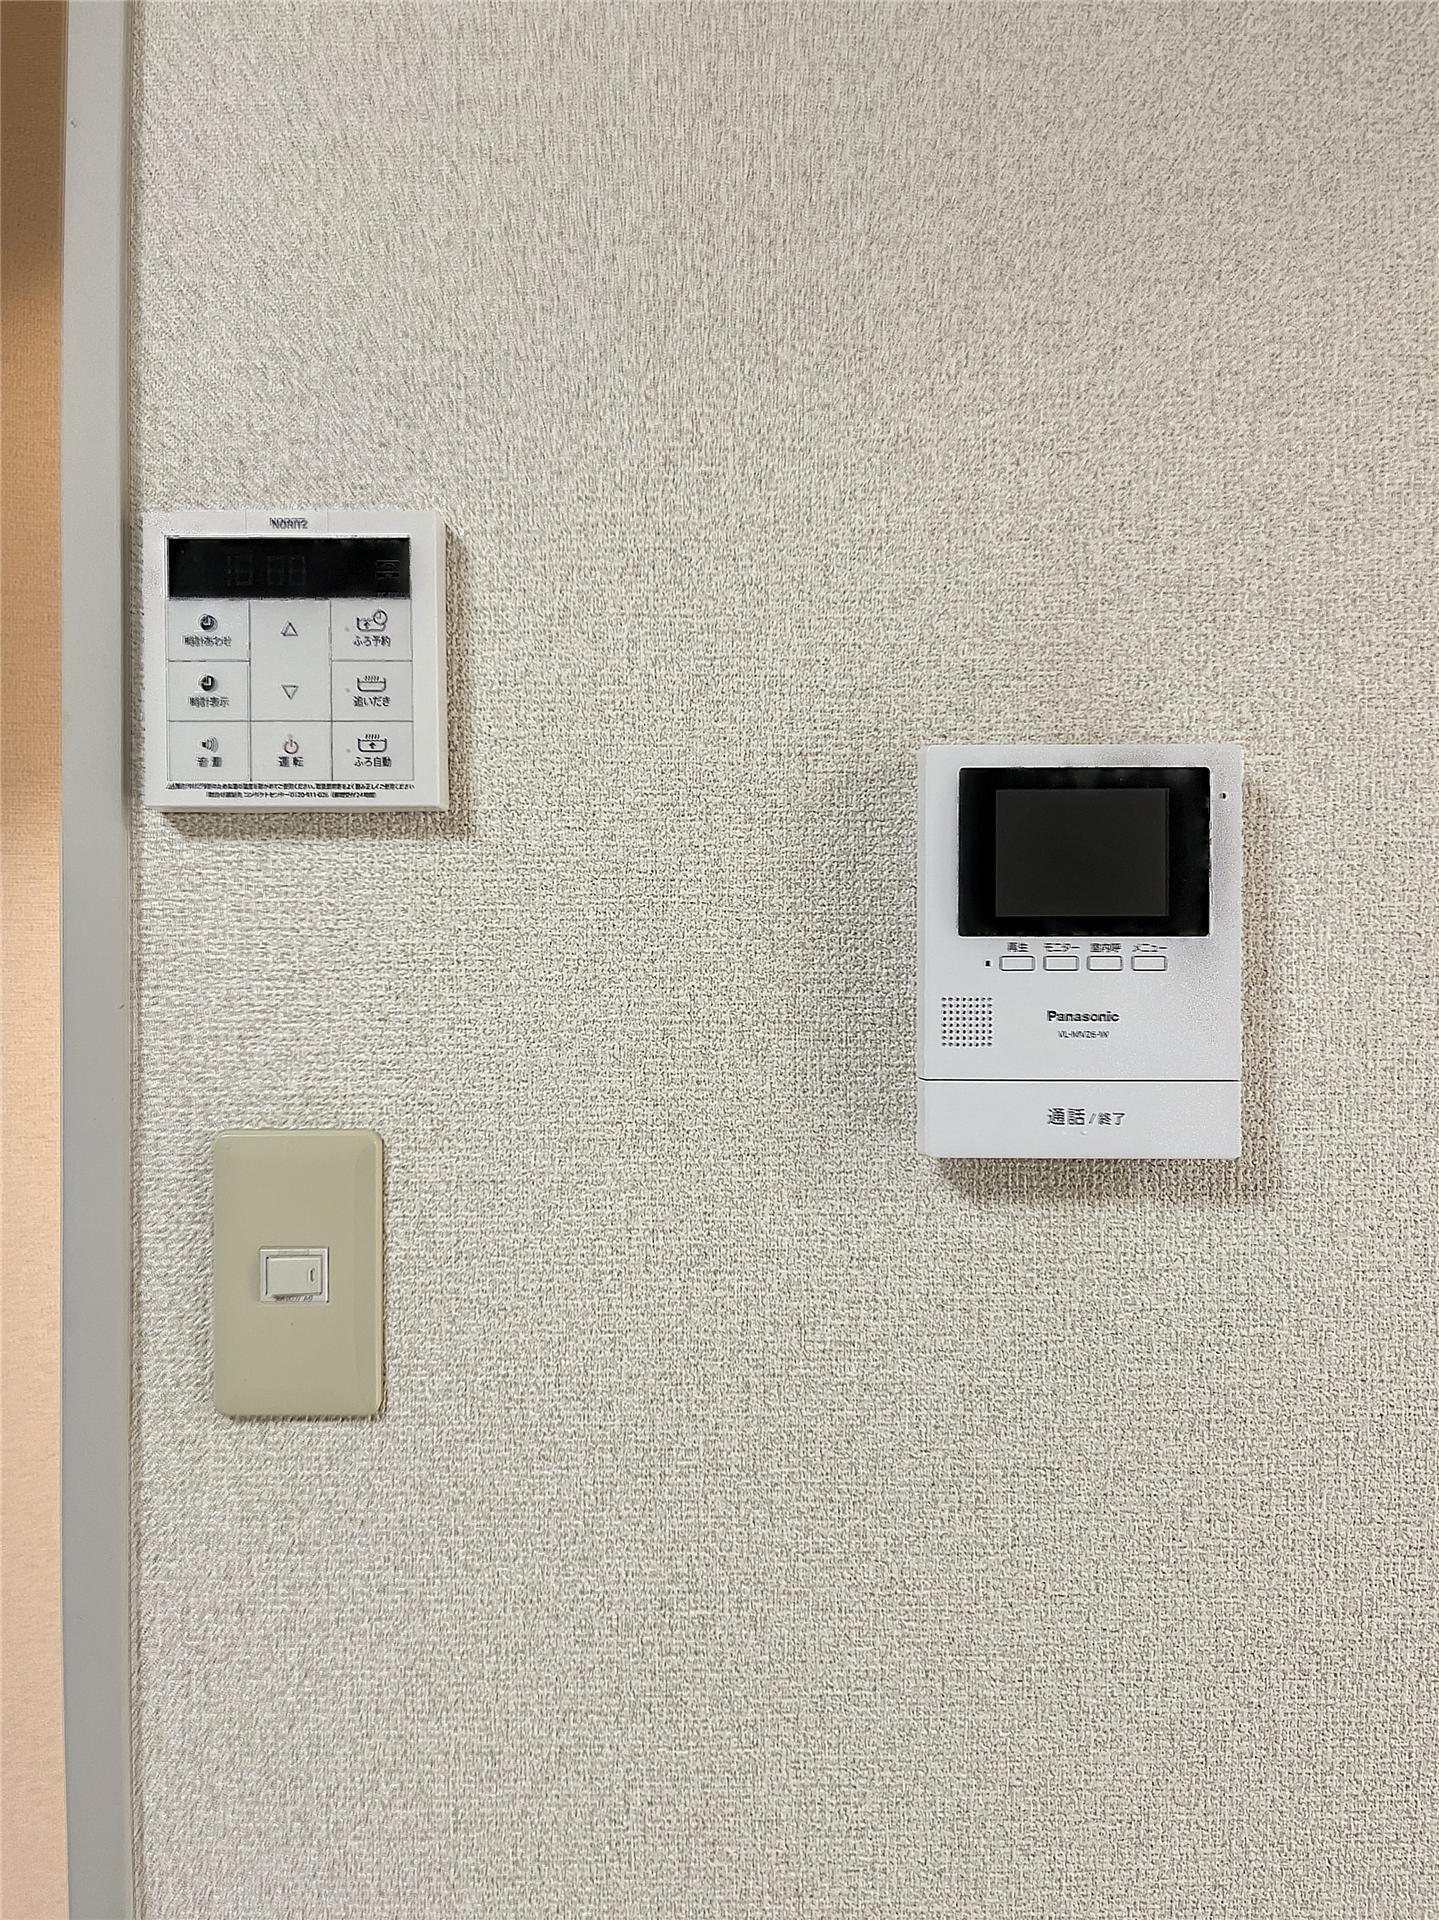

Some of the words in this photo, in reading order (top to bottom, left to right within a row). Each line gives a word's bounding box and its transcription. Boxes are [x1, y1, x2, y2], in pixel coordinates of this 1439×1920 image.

[353, 635, 392, 647] ふろ予約
[188, 696, 230, 708] 時計表示
[352, 695, 391, 708] 追いだき
[354, 756, 392, 768] ふろ自動
[1043, 942, 1080, 952] モニター
[1132, 943, 1168, 952] メニュー
[1046, 1010, 1121, 1022] Panasonic
